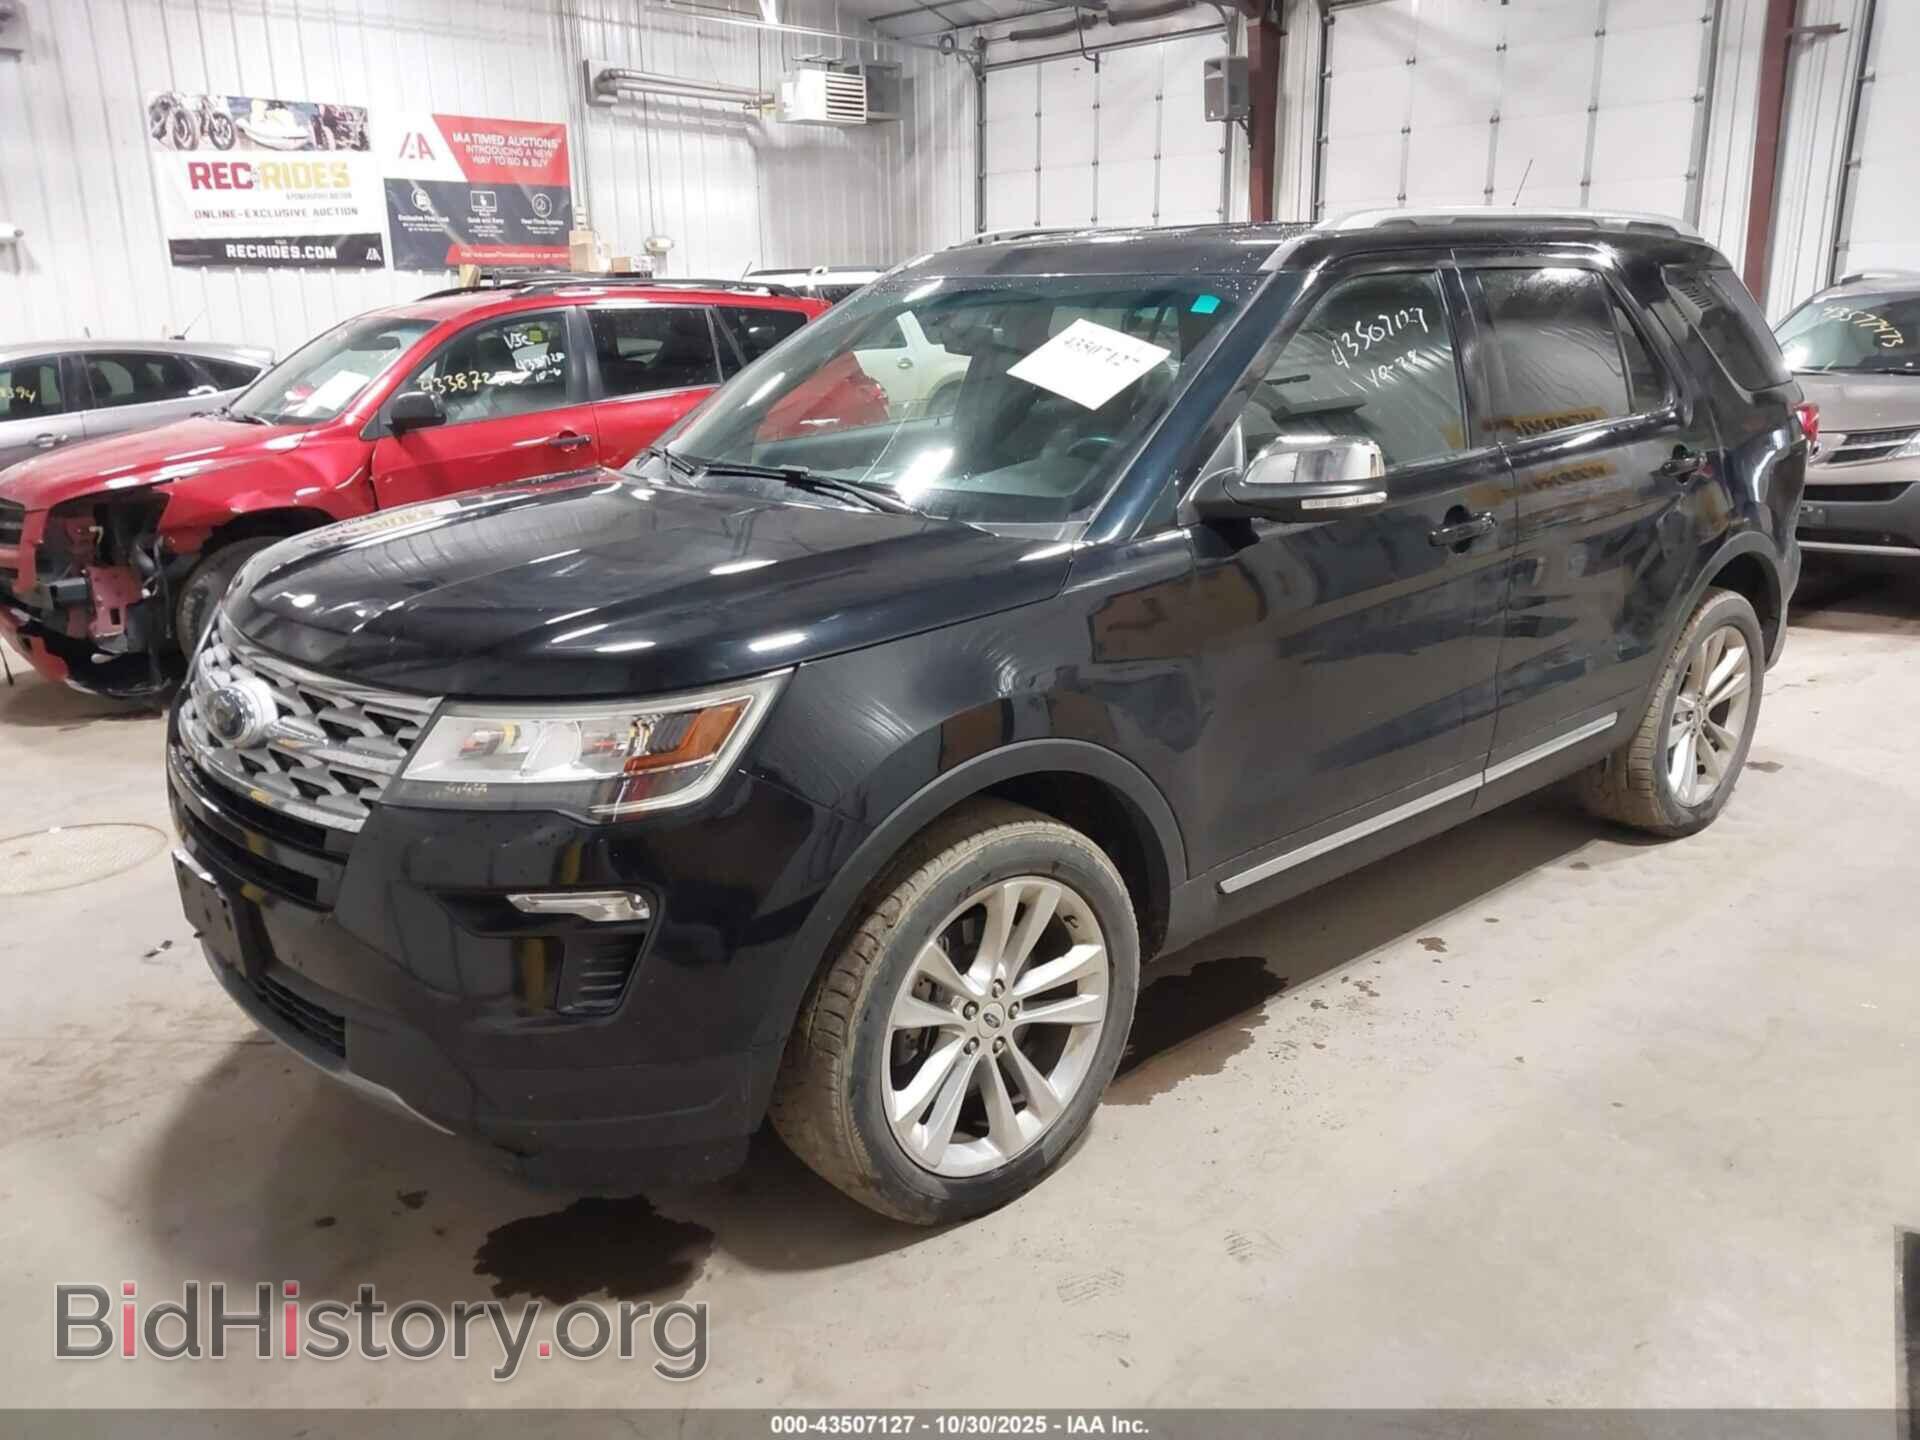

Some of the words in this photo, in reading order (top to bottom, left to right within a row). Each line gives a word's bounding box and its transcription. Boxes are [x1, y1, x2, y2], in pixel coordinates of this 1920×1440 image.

[452, 132, 471, 144] IAA
[472, 133, 505, 147] TIMED
[507, 135, 558, 151] AUCTIONS
[466, 144, 524, 156] INTRODUCING
[472, 156, 491, 165] WAY
[494, 157, 505, 166] TO
[531, 159, 548, 168] BUY
[188, 162, 254, 190] REC
[258, 160, 352, 191] RIDES
[312, 207, 359, 217] AUCTION
[226, 244, 337, 259] RECRIDES.COM
